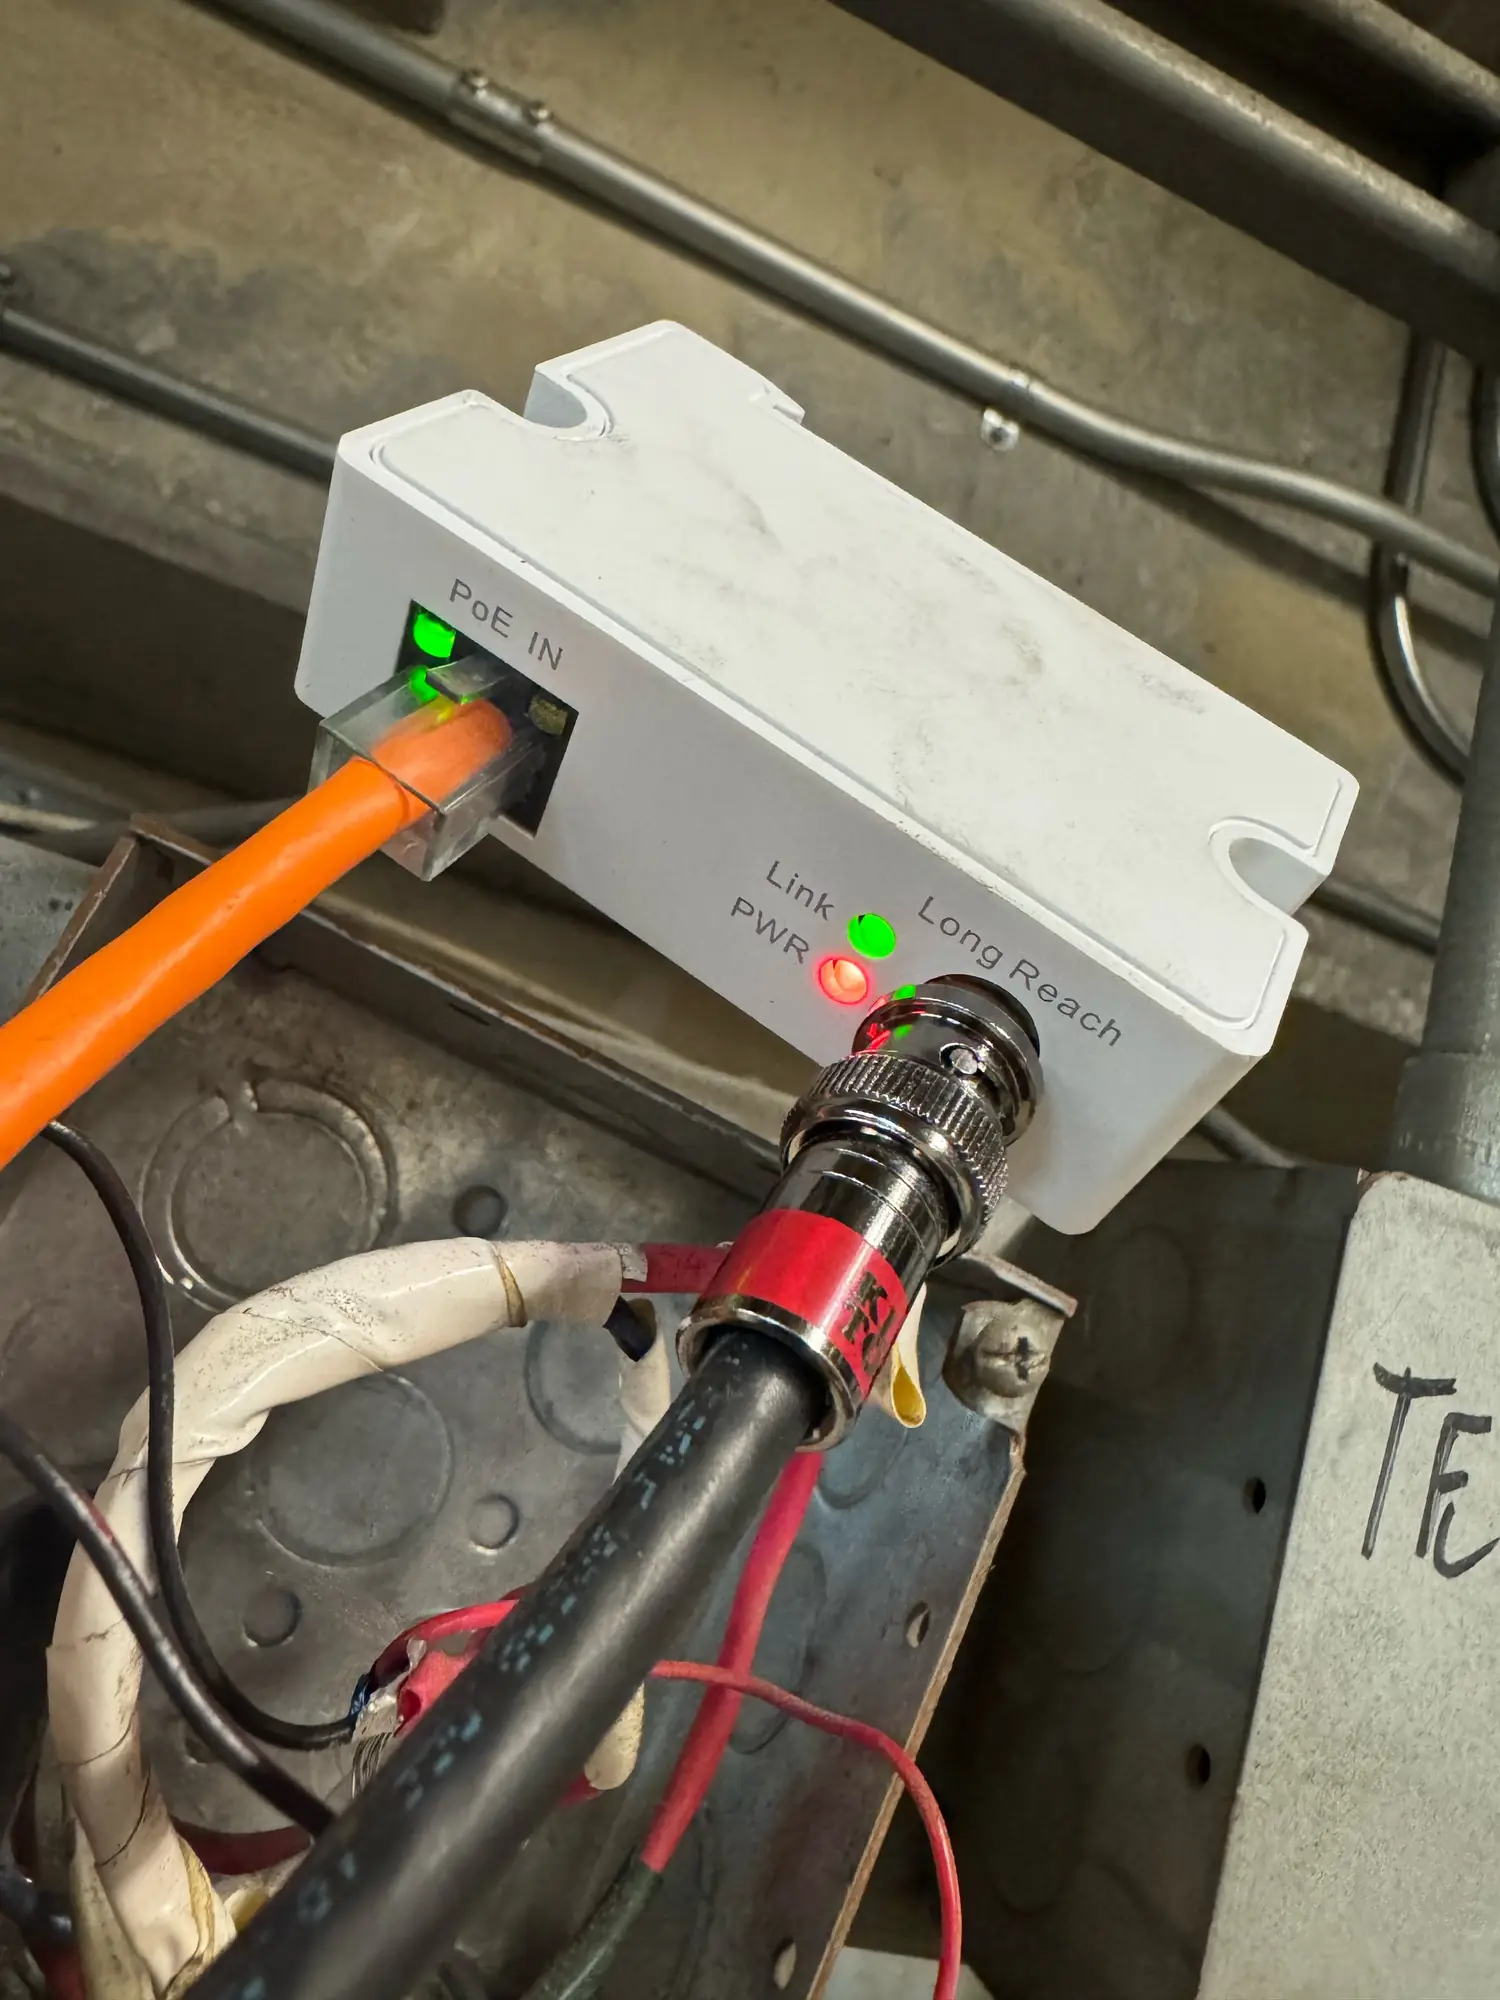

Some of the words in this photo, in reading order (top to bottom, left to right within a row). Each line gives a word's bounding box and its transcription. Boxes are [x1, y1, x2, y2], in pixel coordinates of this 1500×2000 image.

[449, 578, 514, 639] PoE
[527, 631, 564, 671] IN
[730, 896, 809, 964] PWR
[766, 860, 835, 921] Link
[917, 895, 1004, 970] Long
[1008, 958, 1122, 1047] Reach
